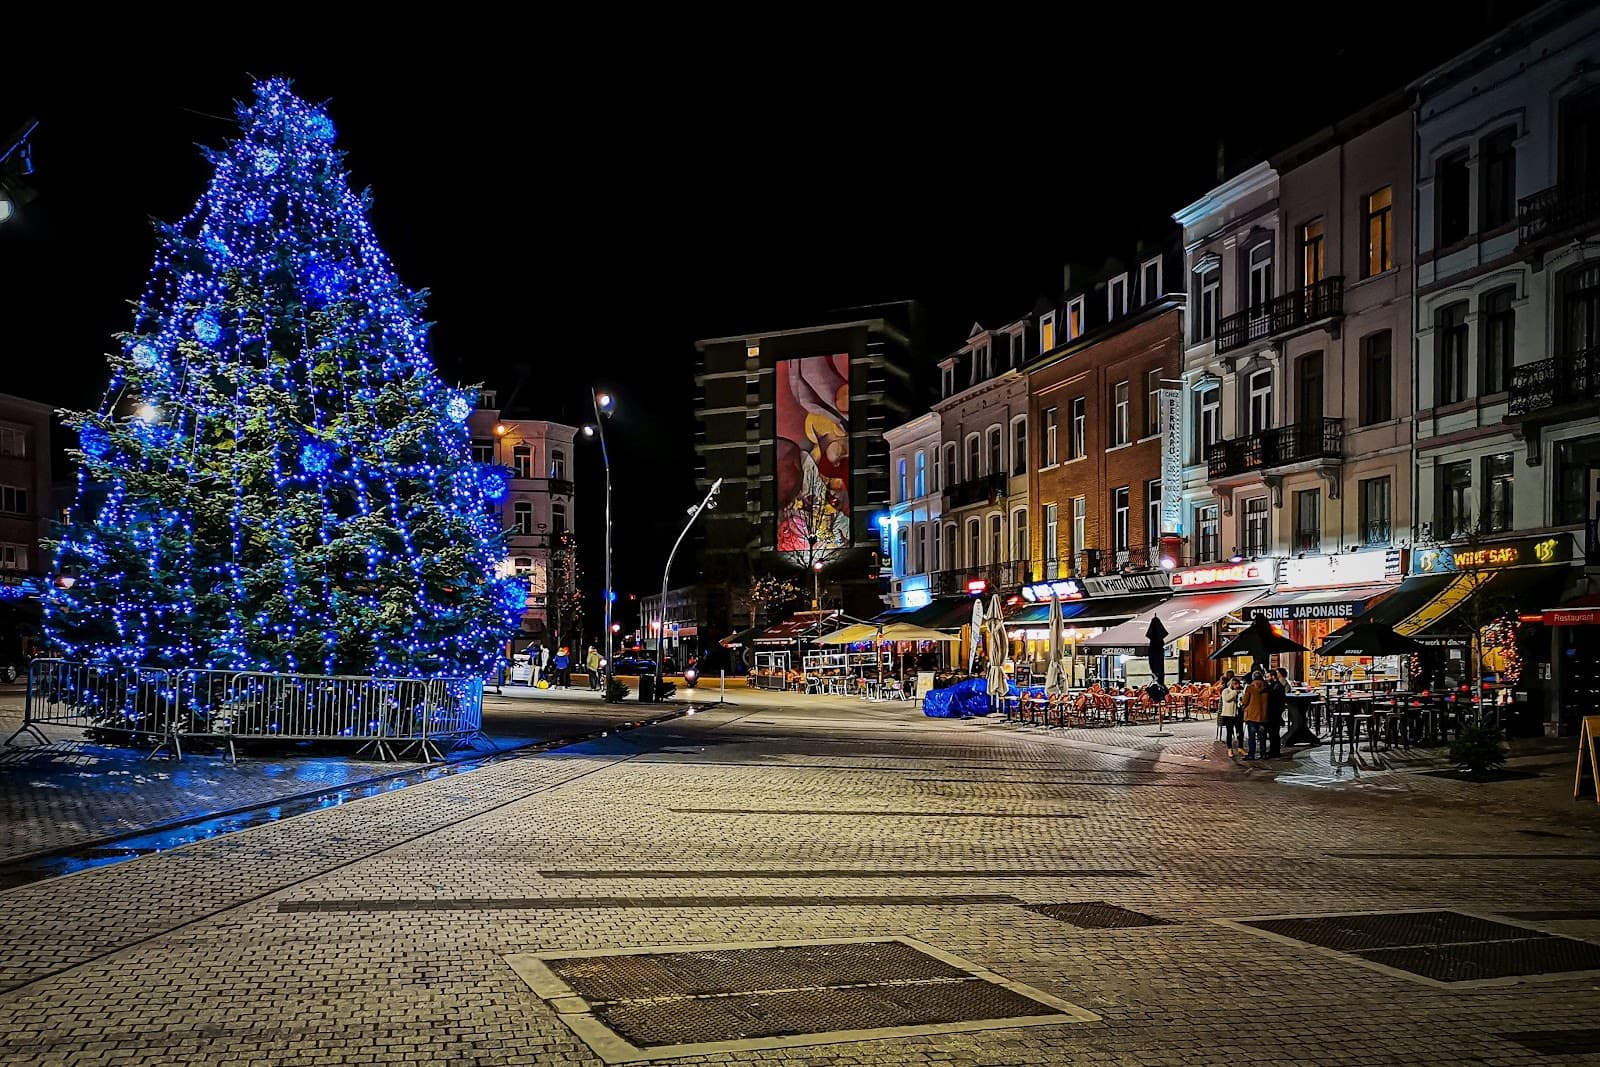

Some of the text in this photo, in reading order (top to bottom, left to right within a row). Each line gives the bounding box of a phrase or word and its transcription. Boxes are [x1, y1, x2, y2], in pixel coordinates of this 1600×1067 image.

[1124, 575, 1149, 590] NIGHT
[1293, 604, 1353, 618] JAPONAISE
[1554, 613, 1594, 622] Restaurant
